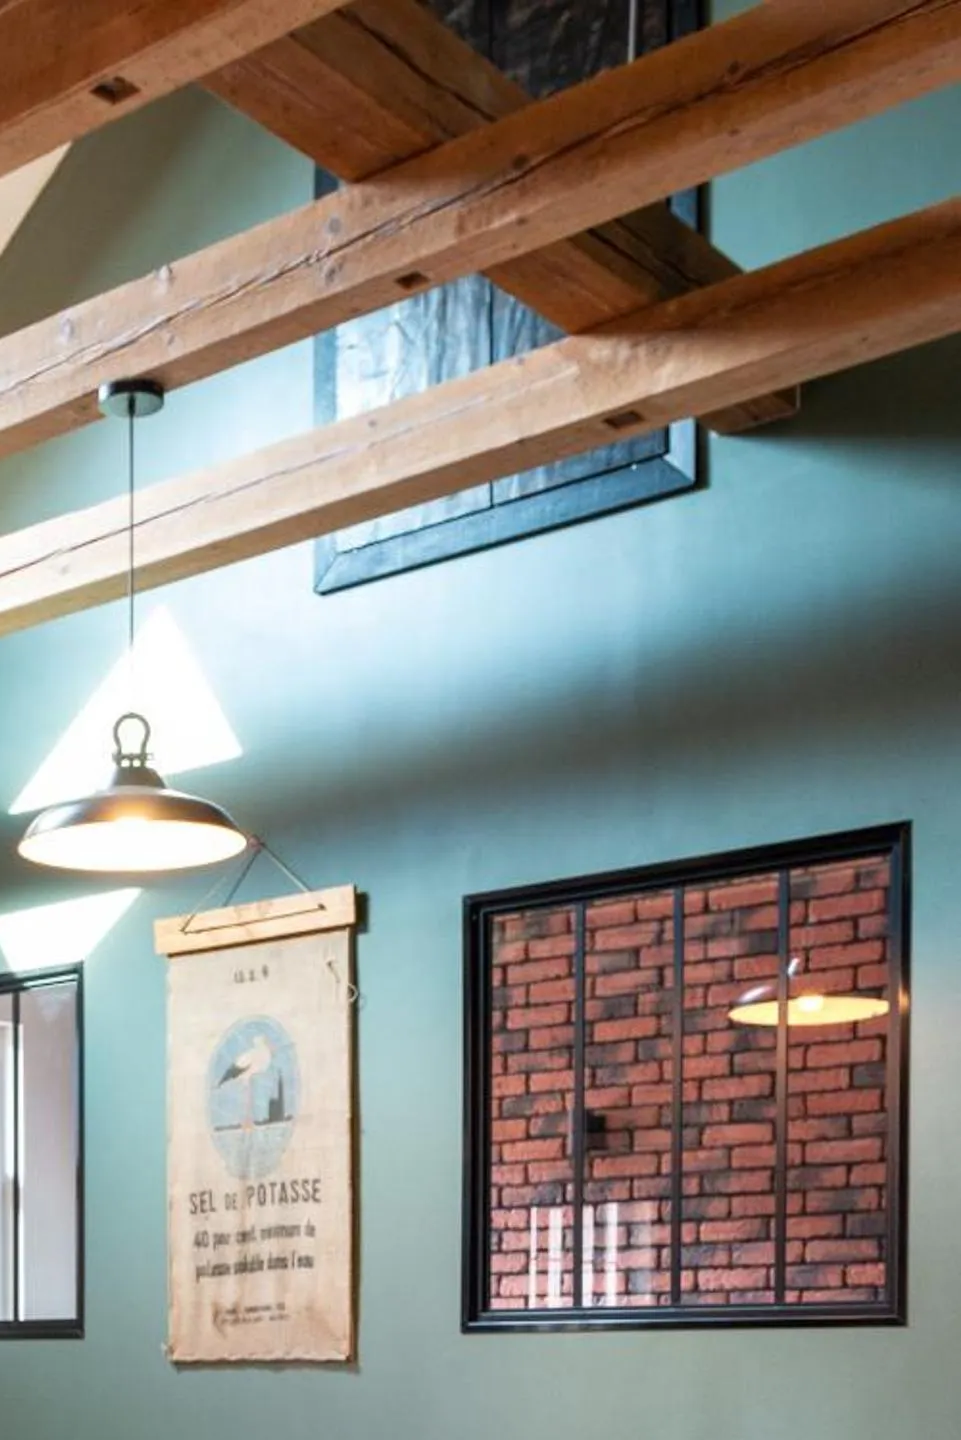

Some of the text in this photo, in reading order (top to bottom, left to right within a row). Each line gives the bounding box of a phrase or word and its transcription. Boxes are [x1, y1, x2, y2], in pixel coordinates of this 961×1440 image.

[189, 1178, 321, 1215] SEL DE POTASSE
[193, 1229, 209, 1248] 40
